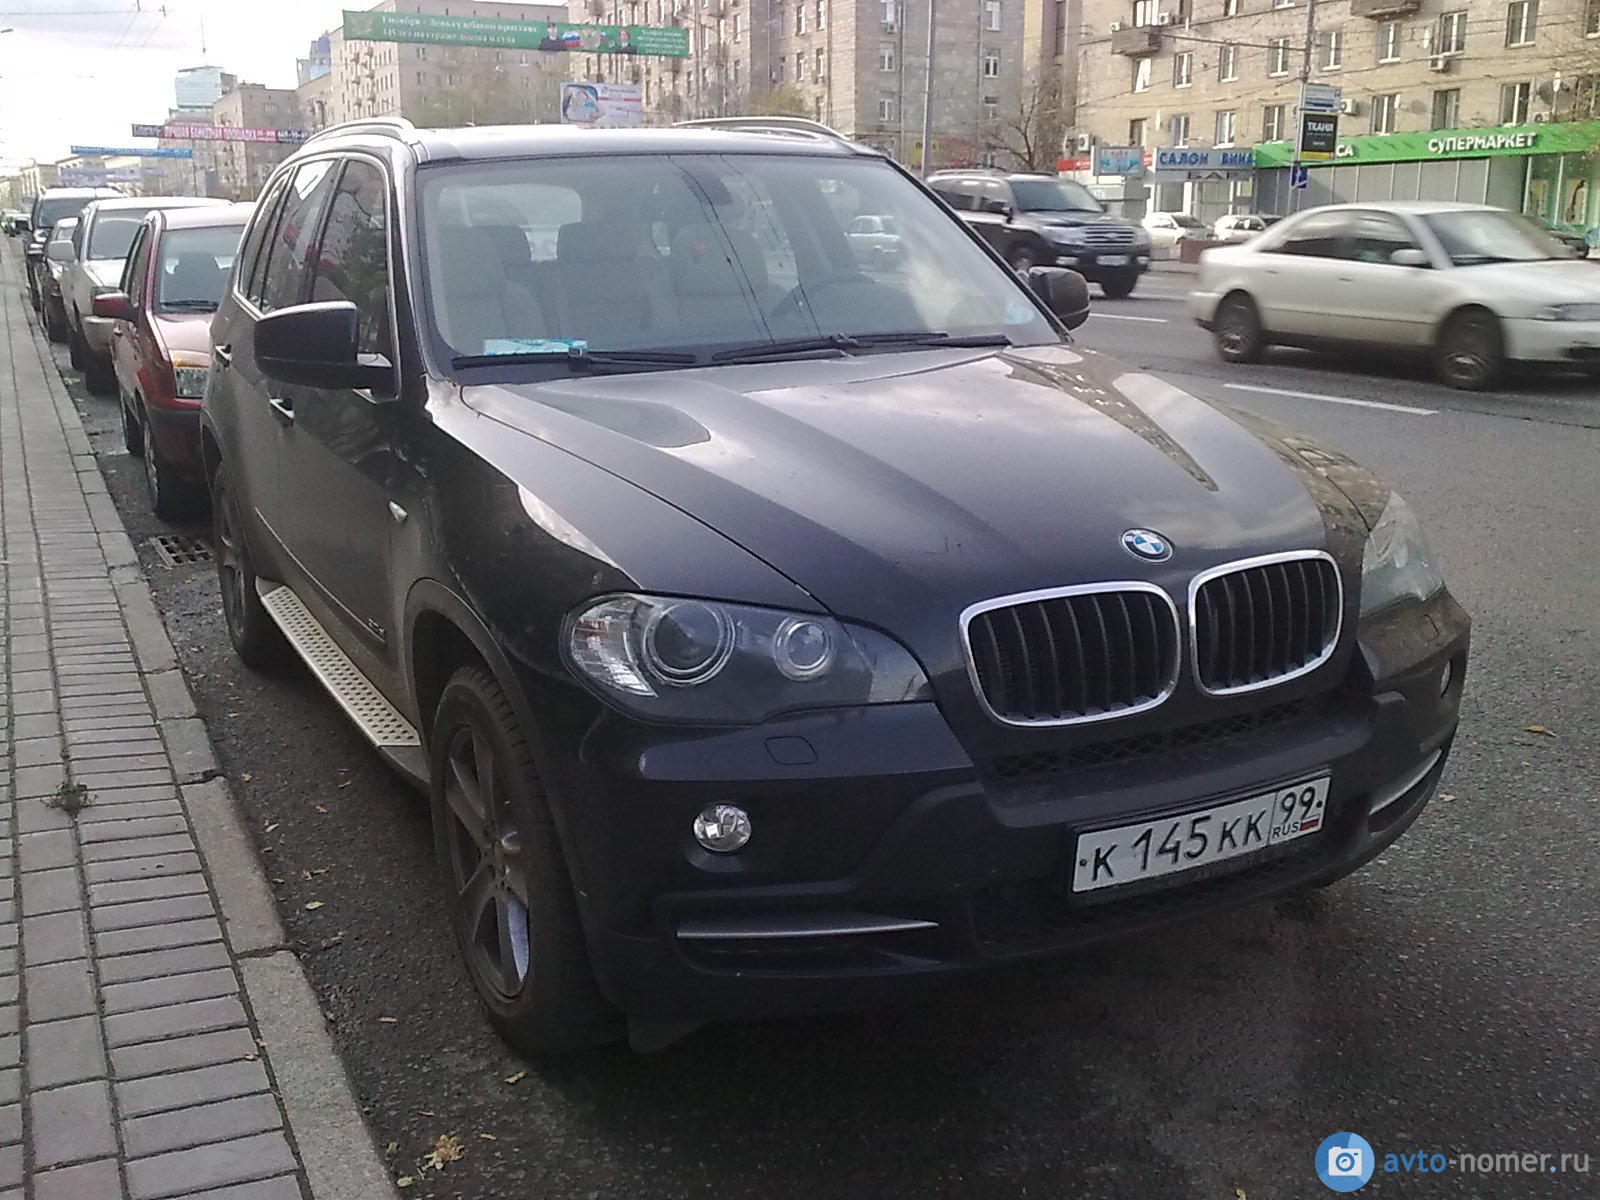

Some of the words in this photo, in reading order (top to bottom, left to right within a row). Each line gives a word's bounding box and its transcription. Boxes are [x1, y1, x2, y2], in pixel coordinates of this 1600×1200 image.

[1428, 132, 1536, 154] СУПЕРМАРКЕТ
[1159, 151, 1209, 166] САЛОН
[1222, 151, 1254, 166] ВИНА
[1280, 785, 1316, 823] 99
[1271, 821, 1300, 838] RUS
